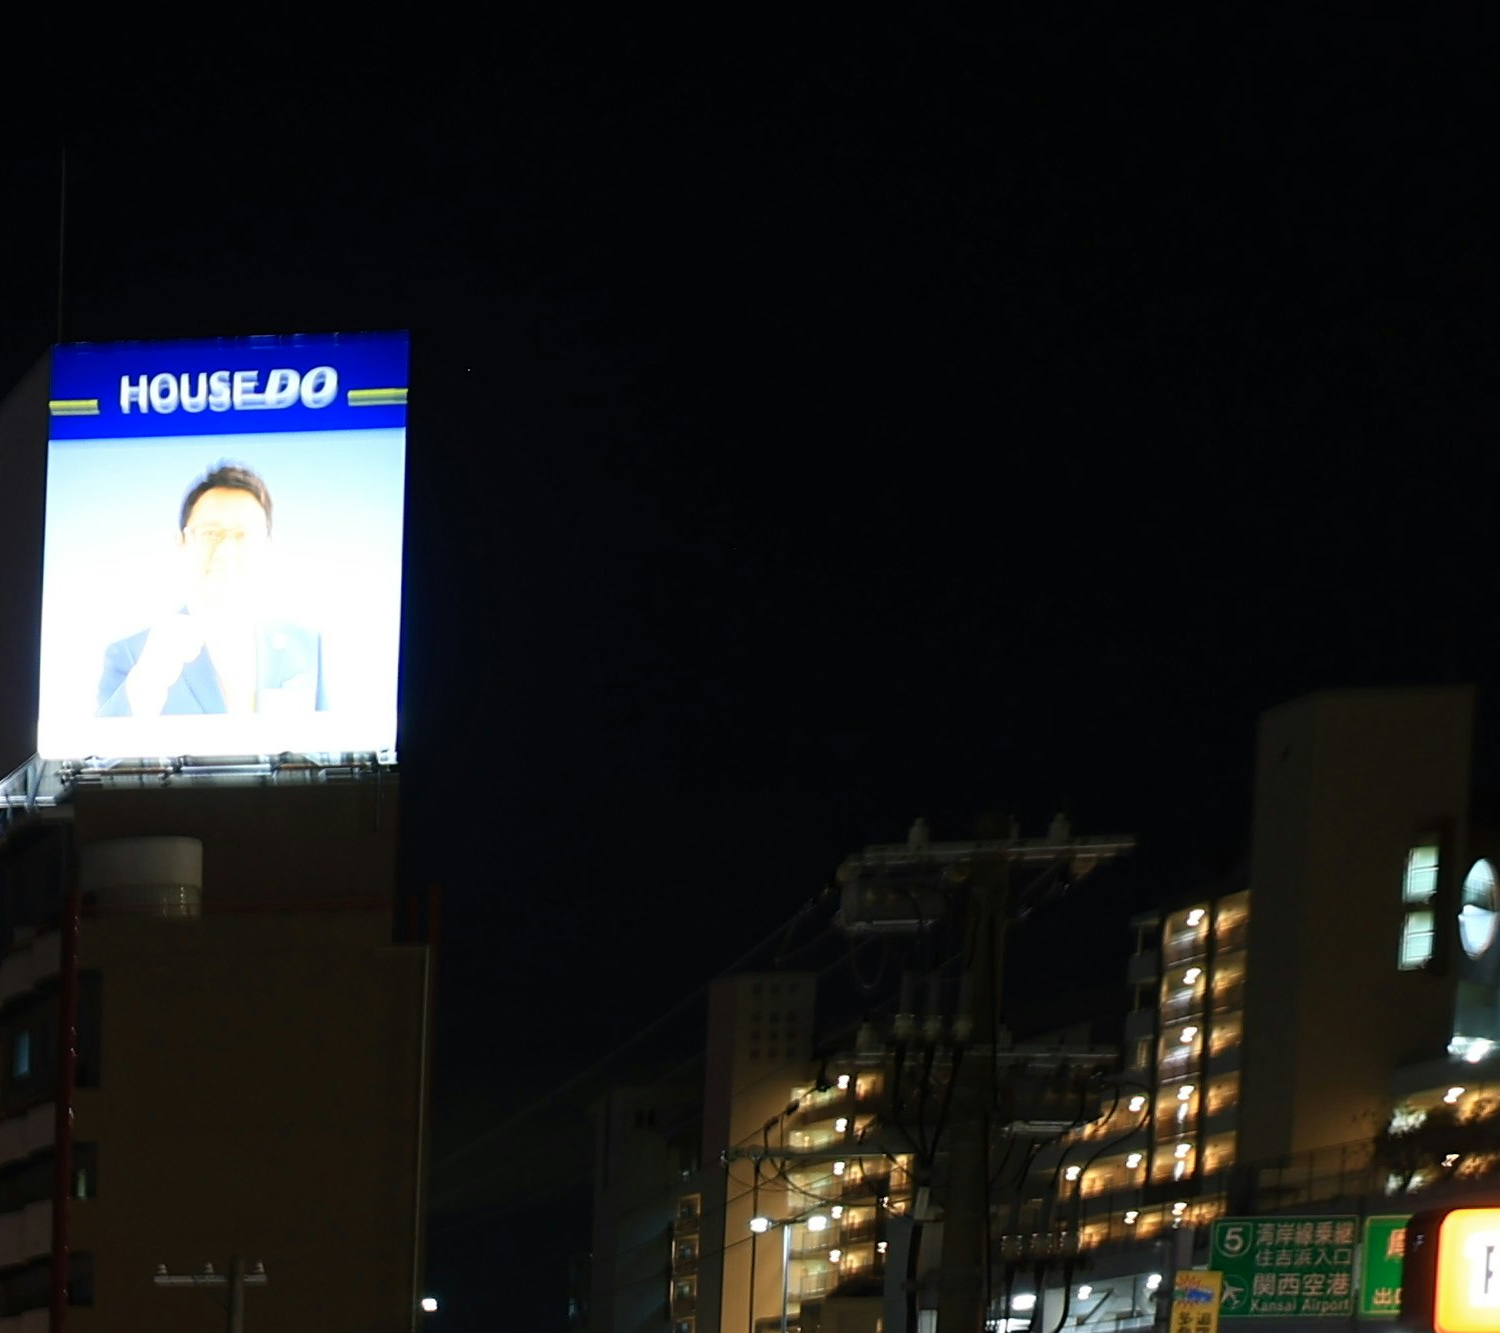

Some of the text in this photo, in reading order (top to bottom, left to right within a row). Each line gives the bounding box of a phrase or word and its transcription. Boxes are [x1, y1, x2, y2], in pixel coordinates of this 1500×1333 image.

[1224, 1226, 1244, 1252] 5
[1256, 1222, 1353, 1246] 湾岸線乗継
[1255, 1248, 1352, 1267] 住吉浜入口
[1253, 1273, 1350, 1297] 関西空港
[1250, 1297, 1350, 1313] Kansai Airport
